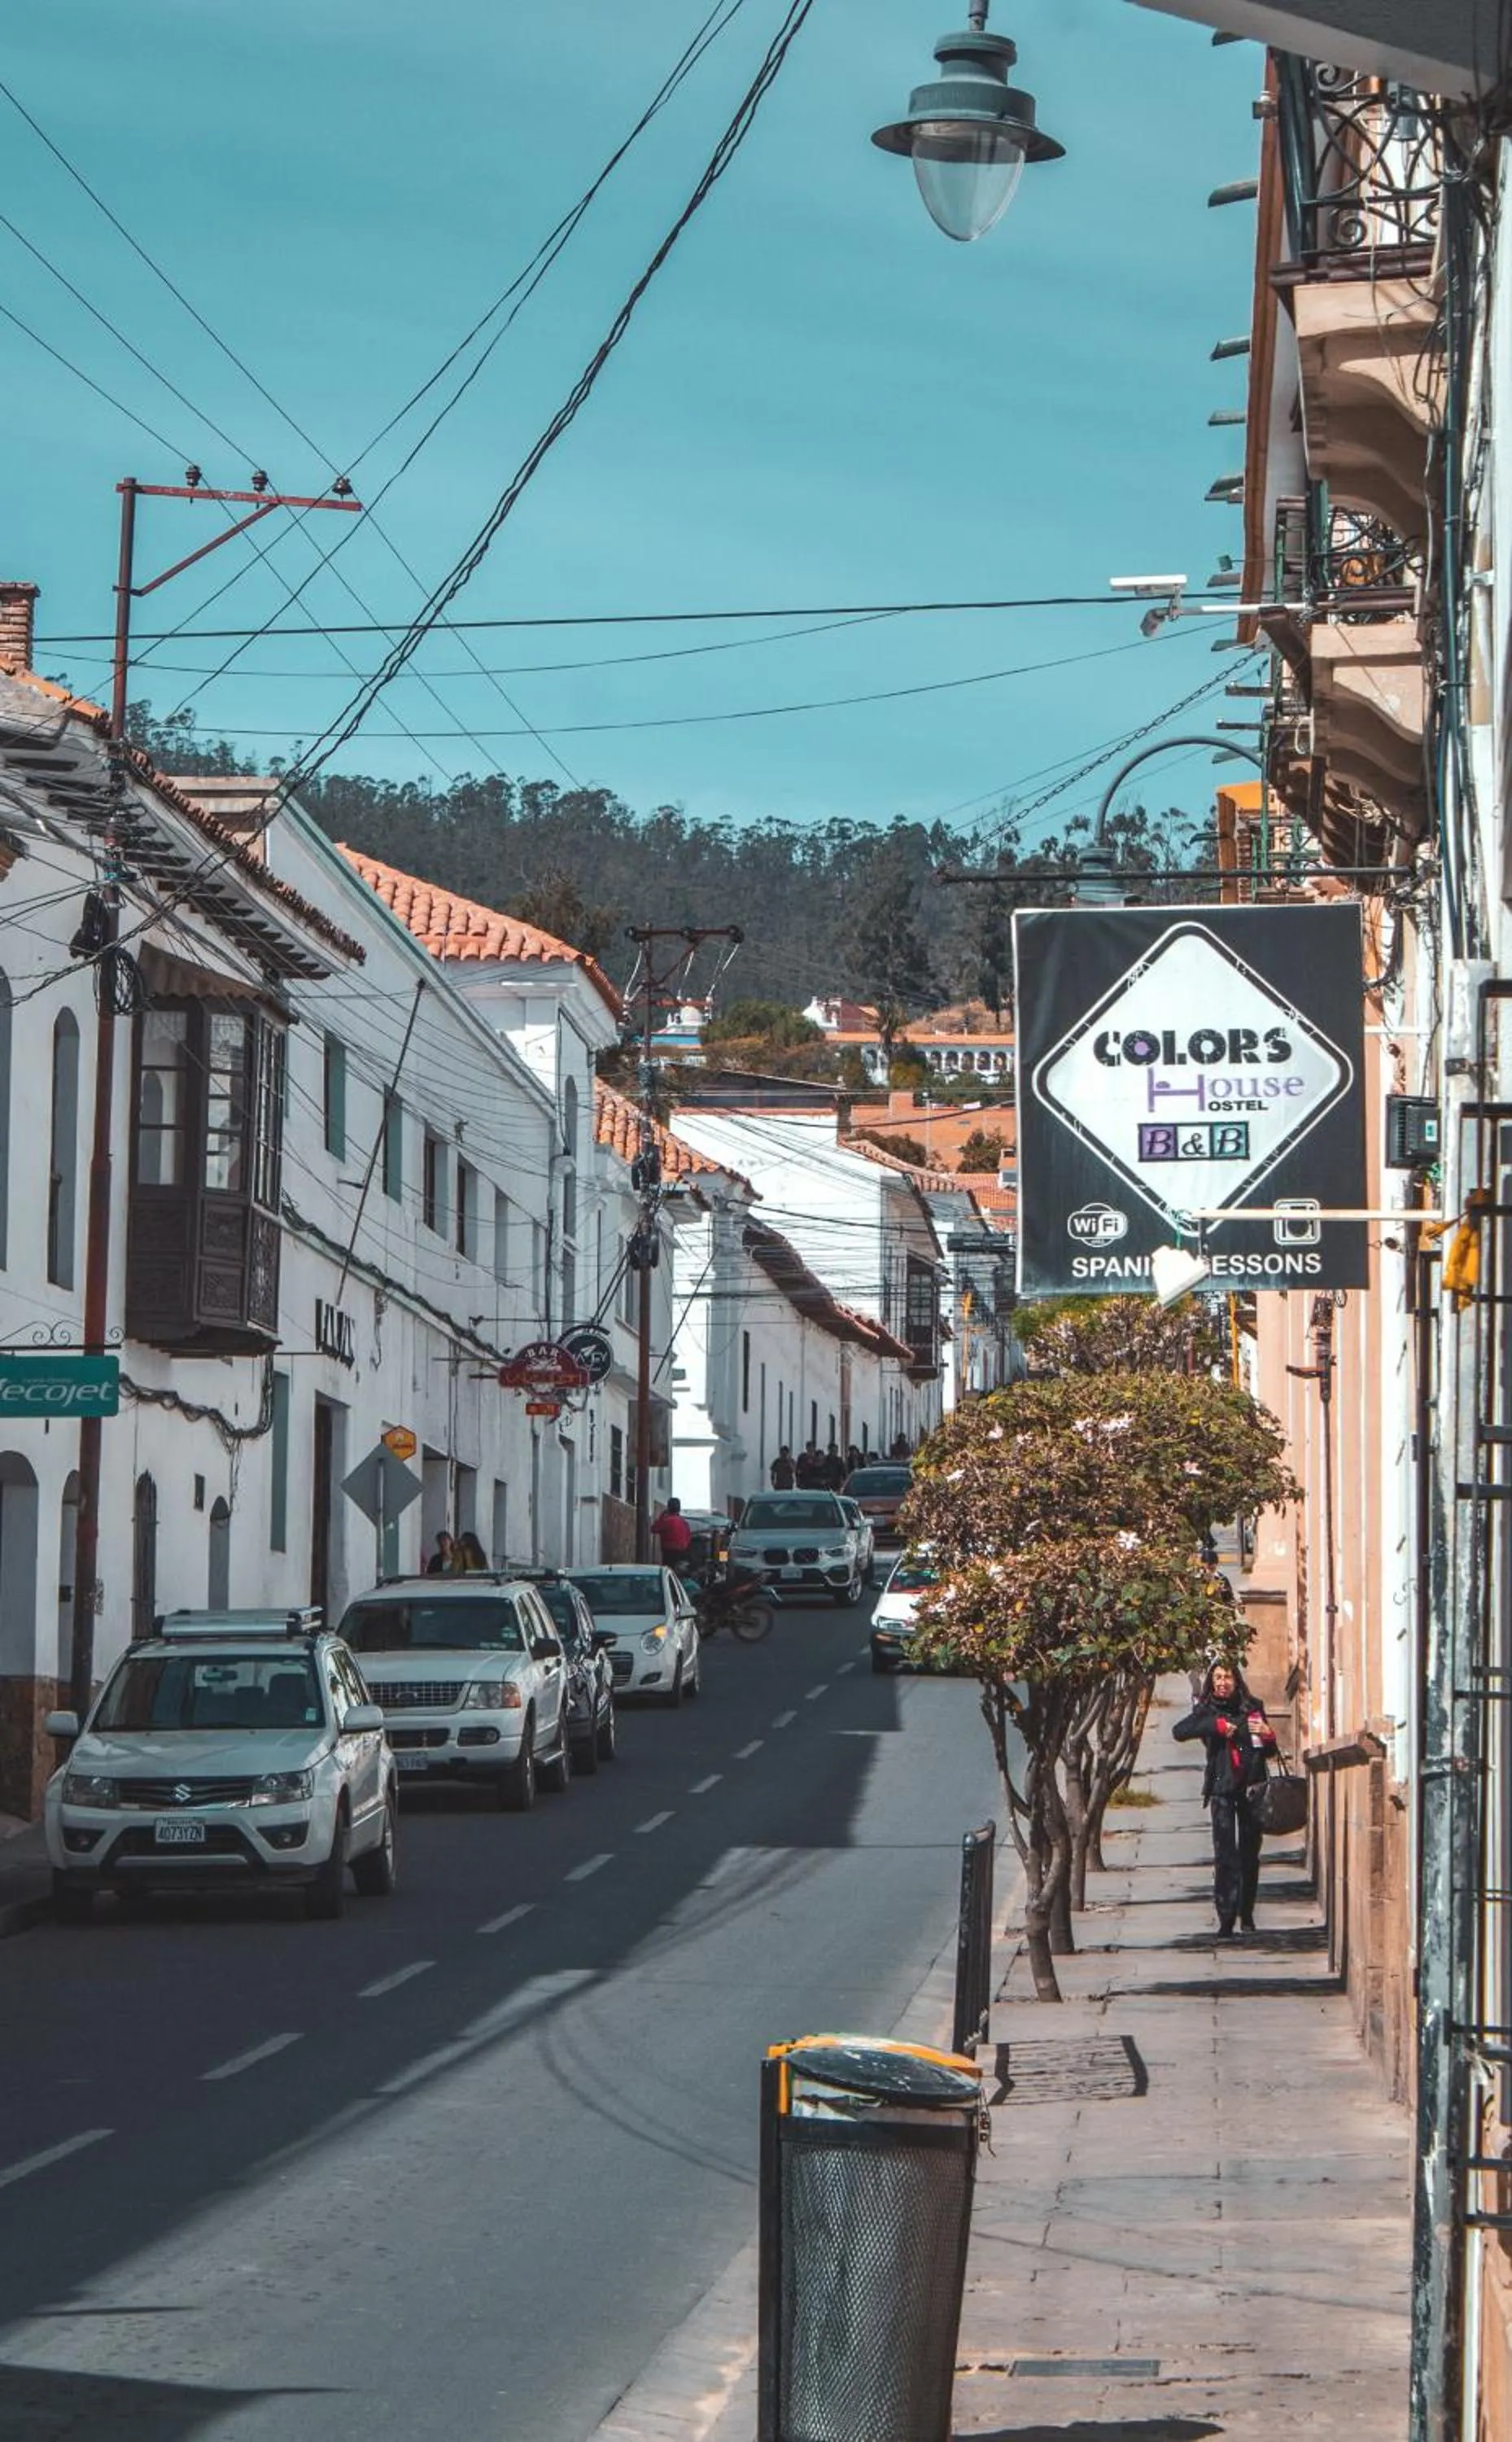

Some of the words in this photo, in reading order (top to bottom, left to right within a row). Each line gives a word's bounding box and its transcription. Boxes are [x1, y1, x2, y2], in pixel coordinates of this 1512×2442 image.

[1093, 1027, 1292, 1067] COLORS
[1148, 1067, 1304, 1113] House
[1146, 1127, 1243, 1157] B&B
[1071, 1256, 1150, 1278] SPANI
[1212, 1253, 1322, 1276] ESSONS
[527, 1346, 559, 1359] BAR
[2, 1381, 115, 1407] ecojet
